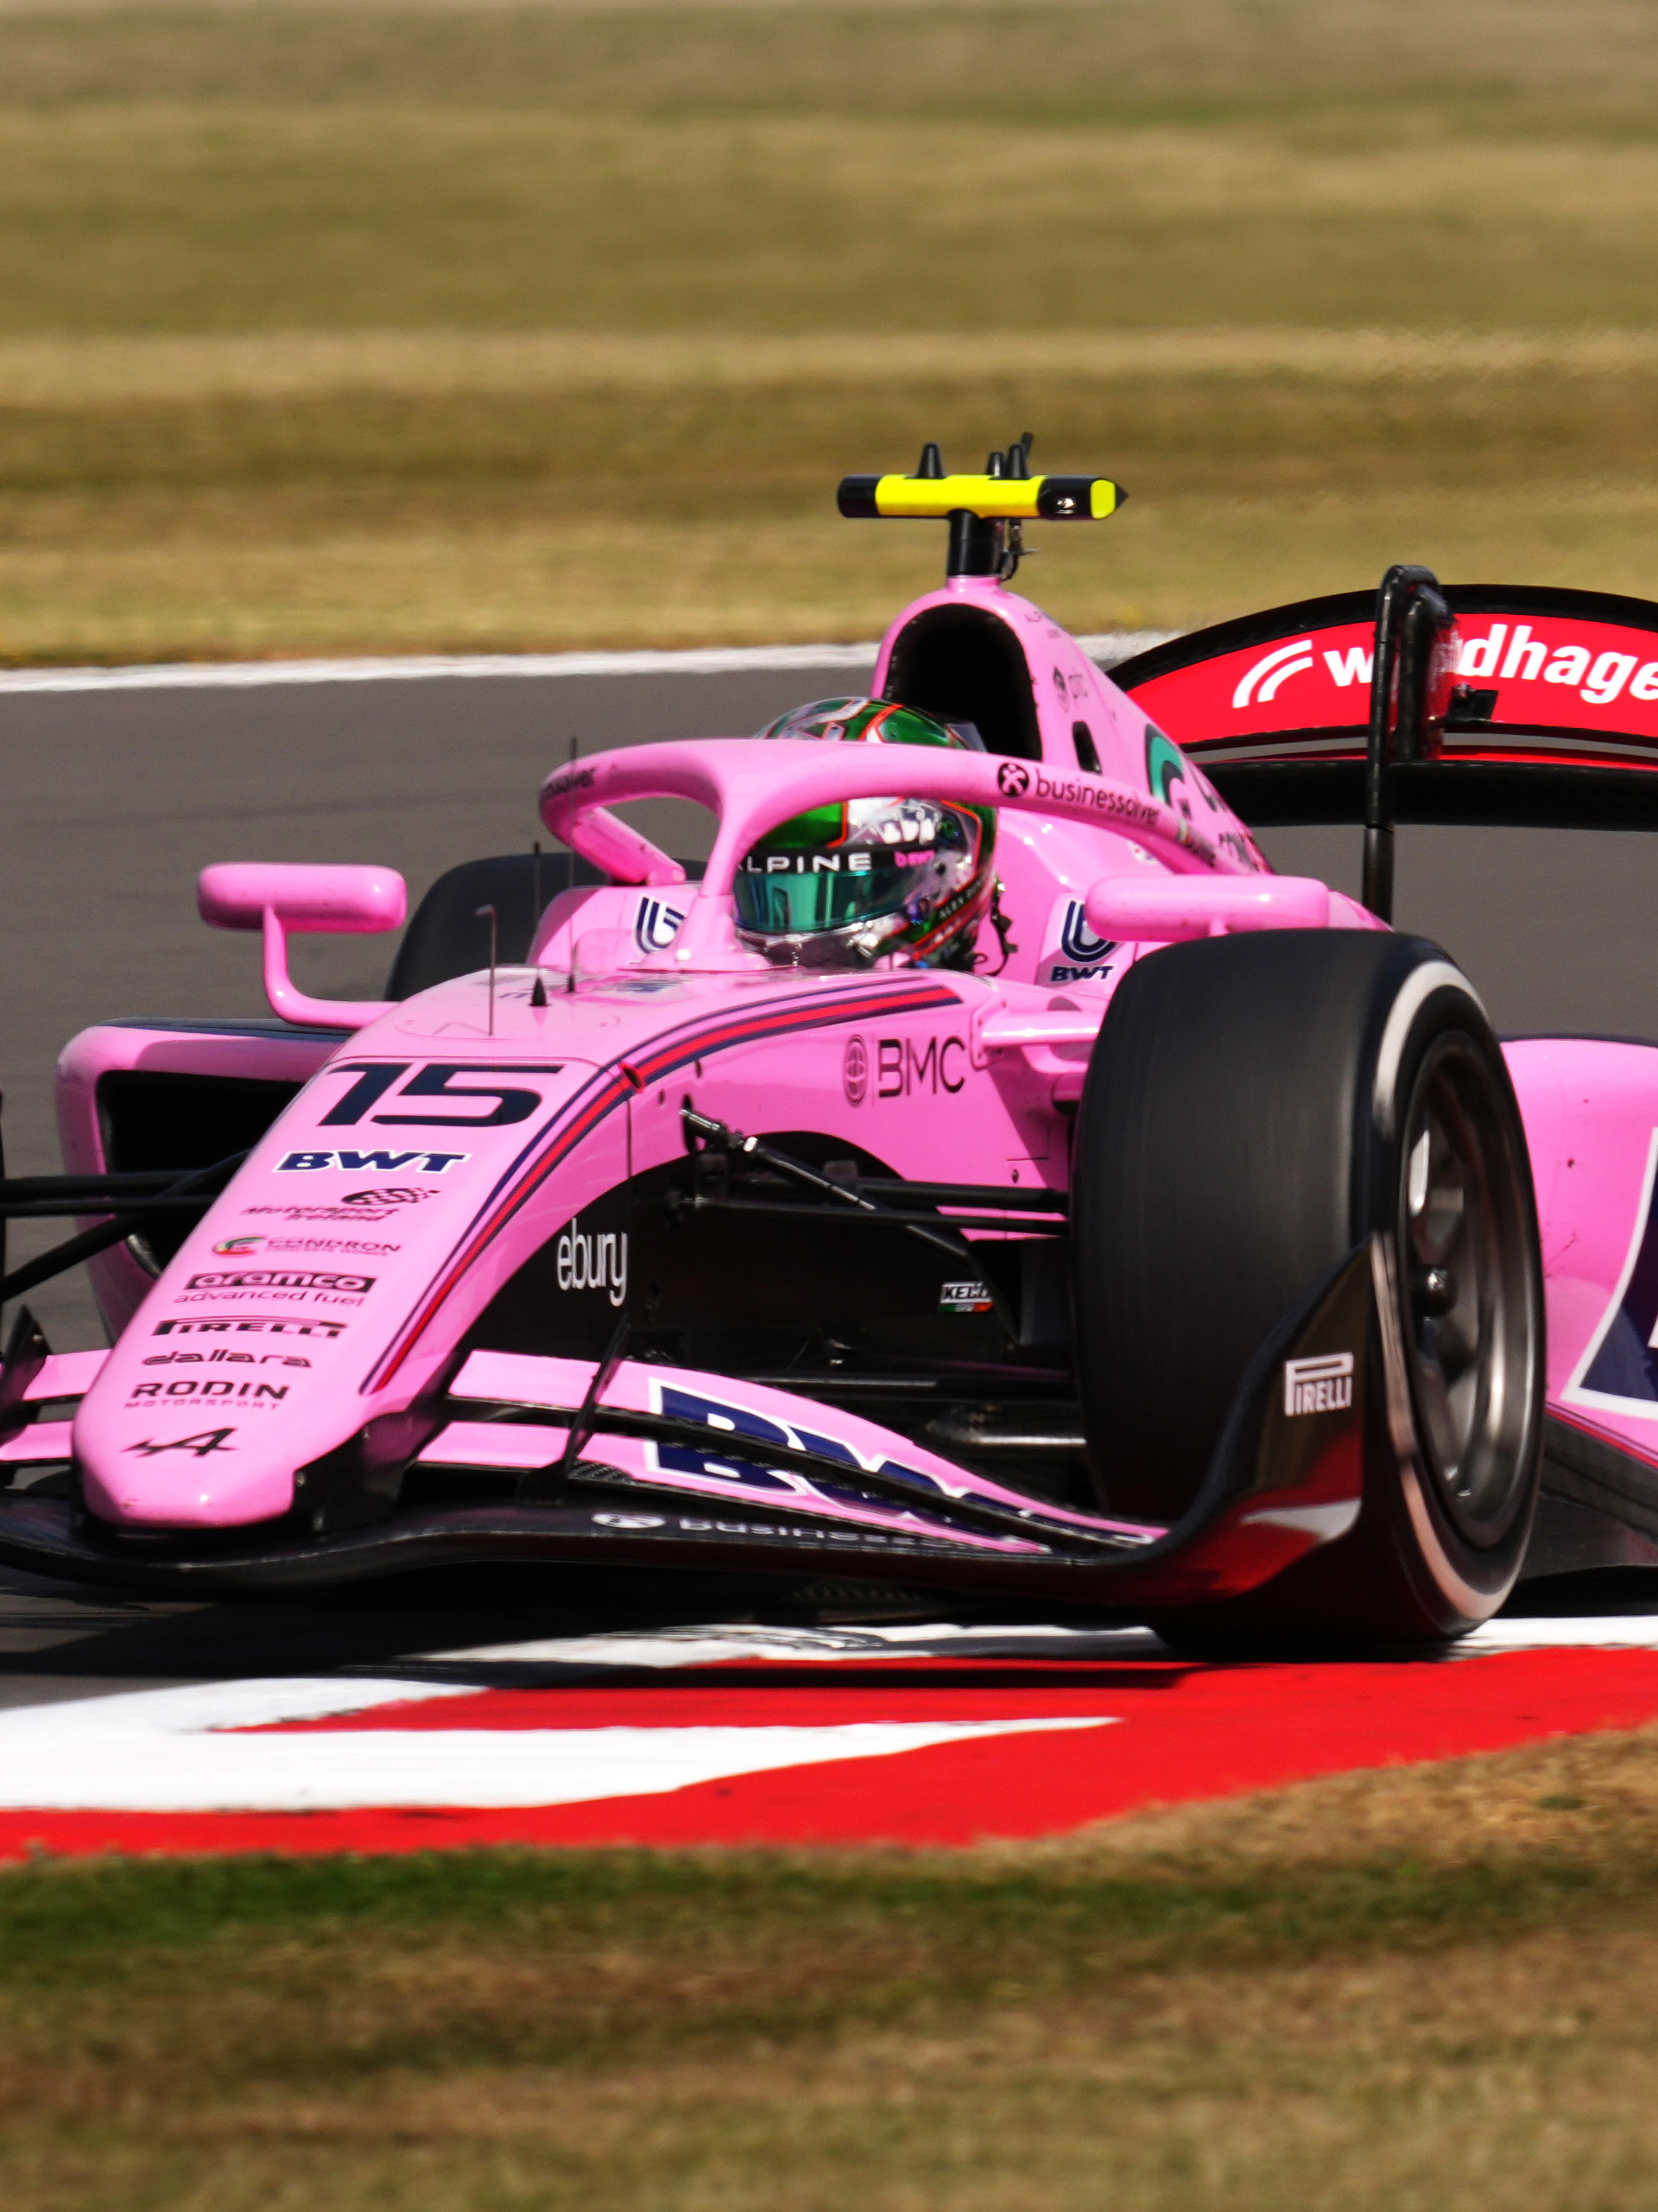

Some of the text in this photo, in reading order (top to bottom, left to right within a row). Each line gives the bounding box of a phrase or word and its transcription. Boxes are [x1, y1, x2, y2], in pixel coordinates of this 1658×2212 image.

[1324, 624, 1658, 704] wdhage
[1035, 767, 1161, 827] businessolver
[738, 852, 871, 874] LPINE
[1050, 965, 1115, 982] BWT
[877, 1036, 965, 1098] BMC
[316, 1062, 566, 1127] 15
[273, 1150, 472, 1172] BWT
[266, 1237, 402, 1252] CONDRON
[557, 1217, 628, 1307] ebury
[193, 1272, 367, 1291] aramco
[174, 1290, 366, 1307] advanced fuel
[151, 1315, 348, 1339] PIRELLI
[142, 1349, 313, 1368] dallara
[130, 1380, 290, 1400] RODIN
[1285, 1352, 1354, 1417] PIRELLI
[123, 1398, 282, 1410] MOTORSPORT
